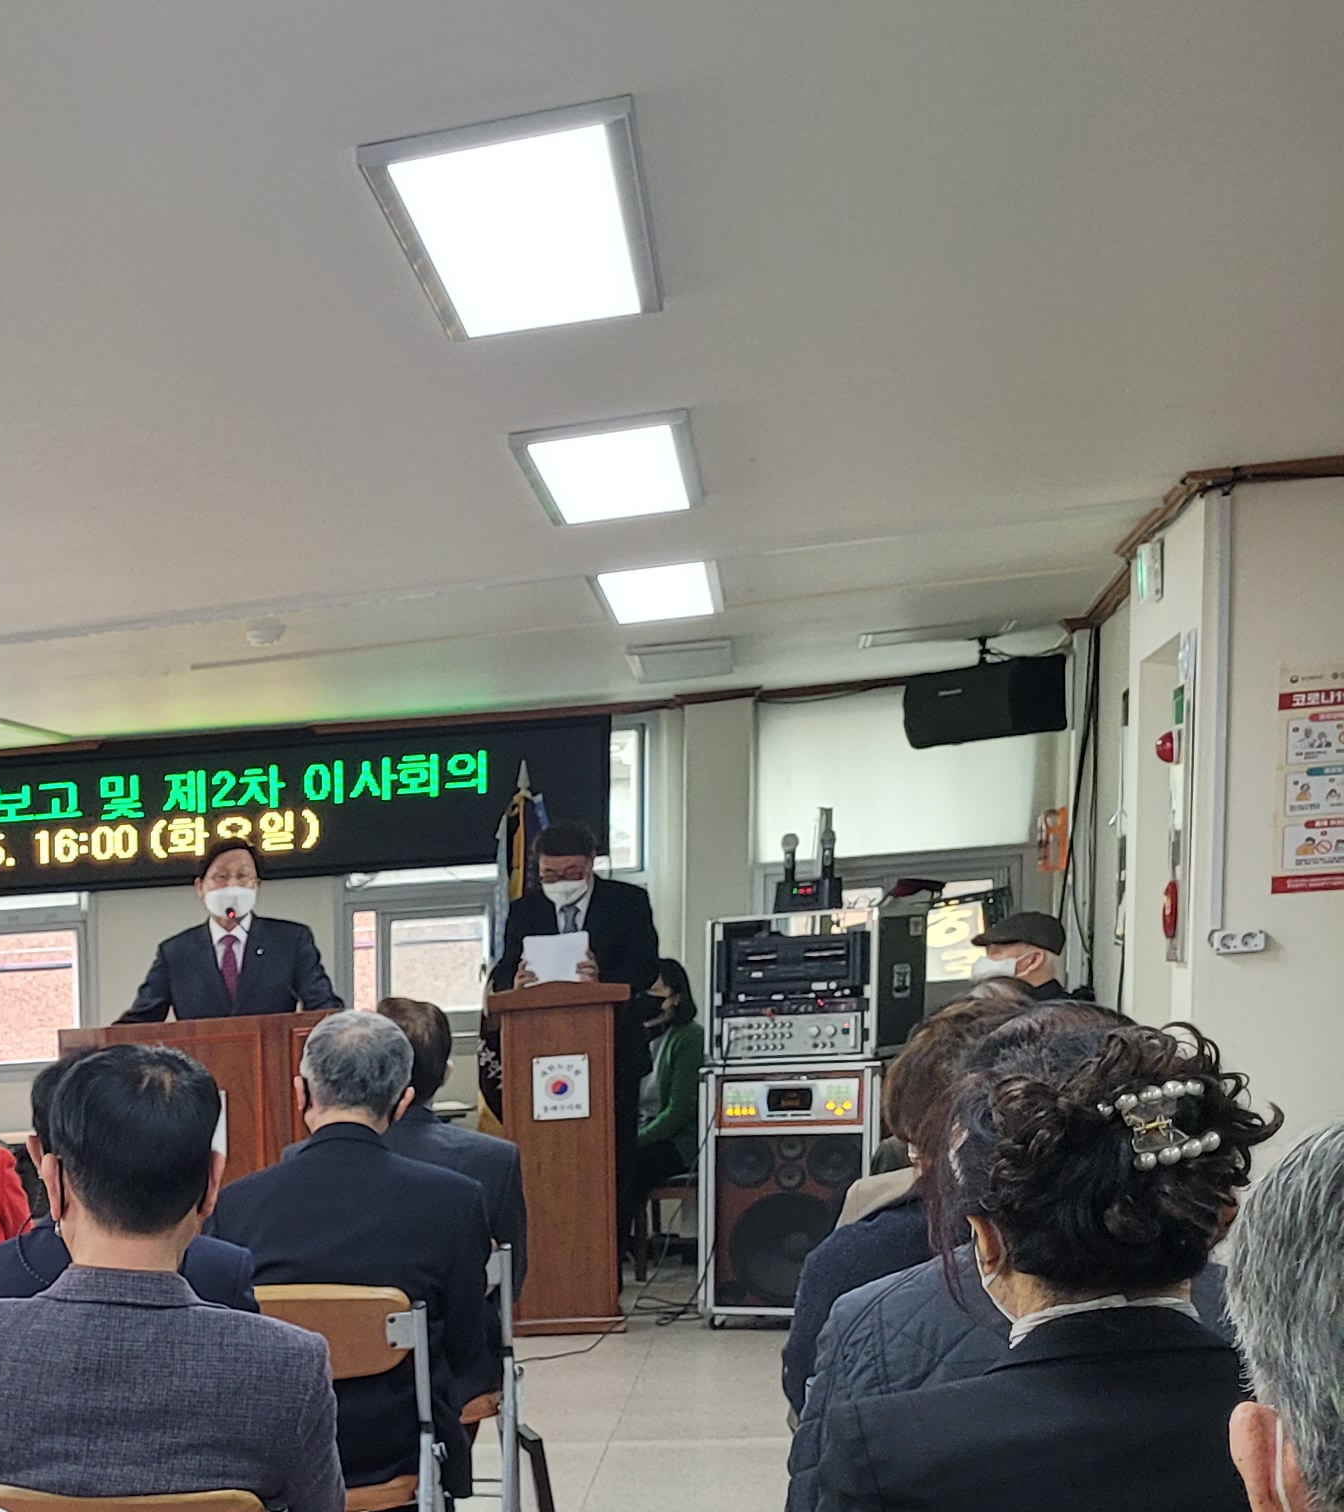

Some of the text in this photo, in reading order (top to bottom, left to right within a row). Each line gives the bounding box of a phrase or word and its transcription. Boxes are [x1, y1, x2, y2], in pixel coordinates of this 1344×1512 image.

[1291, 691, 1344, 708] 코로나1
[98, 774, 145, 821] 및
[162, 764, 286, 814] 제2차
[303, 749, 489, 805] 이사회의
[34, 823, 139, 865] 16:00
